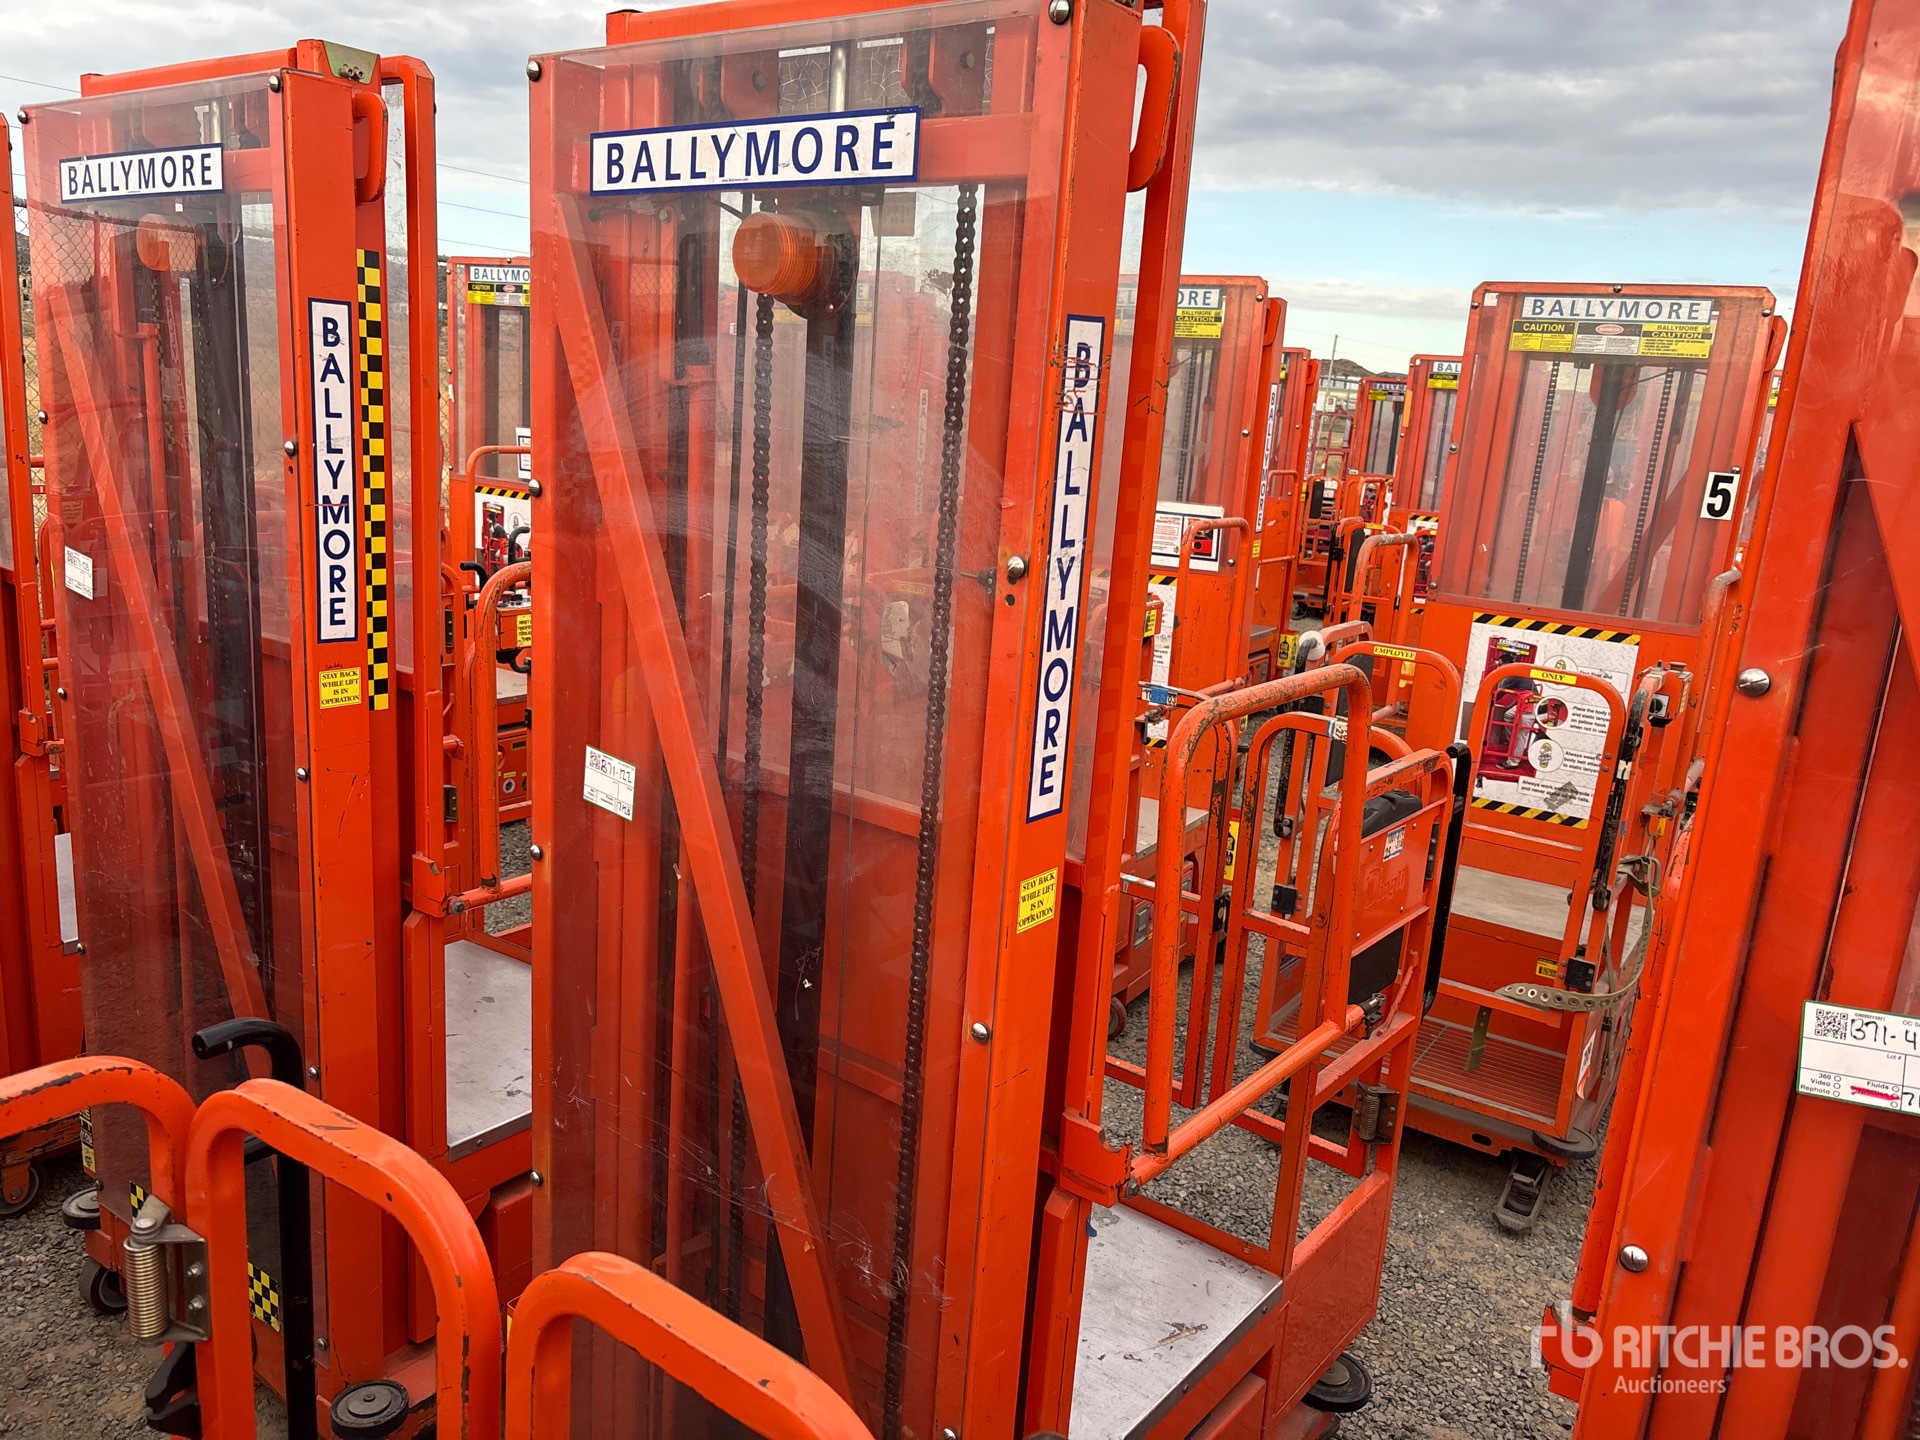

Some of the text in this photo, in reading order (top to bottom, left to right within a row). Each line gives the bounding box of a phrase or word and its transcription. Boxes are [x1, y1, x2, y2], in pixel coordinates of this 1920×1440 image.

[606, 119, 896, 185] BALLYMORE
[68, 152, 213, 196] BALLYMORE
[1531, 298, 1702, 320] BALLYMORE
[1522, 323, 1566, 332] CAUTION
[1656, 324, 1700, 332] BALLYMORE
[1651, 331, 1703, 339] CAUTION
[319, 316, 351, 627] BALLYMORE
[1706, 474, 1735, 518] 5
[1038, 341, 1092, 797] BALLYMORE
[1374, 646, 1415, 659] EMPLOYEE
[322, 670, 358, 680] STAY BACK
[1541, 672, 1566, 682] ONLY
[322, 680, 344, 688] WHILE
[321, 695, 360, 705] OPERATION
[1022, 871, 1056, 892] STAY BACK
[1021, 882, 1056, 903] WHILE LIFT
[1030, 898, 1045, 911] IS IN
[1018, 905, 1054, 928] OPERATION
[1810, 1078, 1831, 1087] Video
[1866, 1081, 1889, 1090] Fluids
[1800, 1084, 1831, 1095] Rephoto
